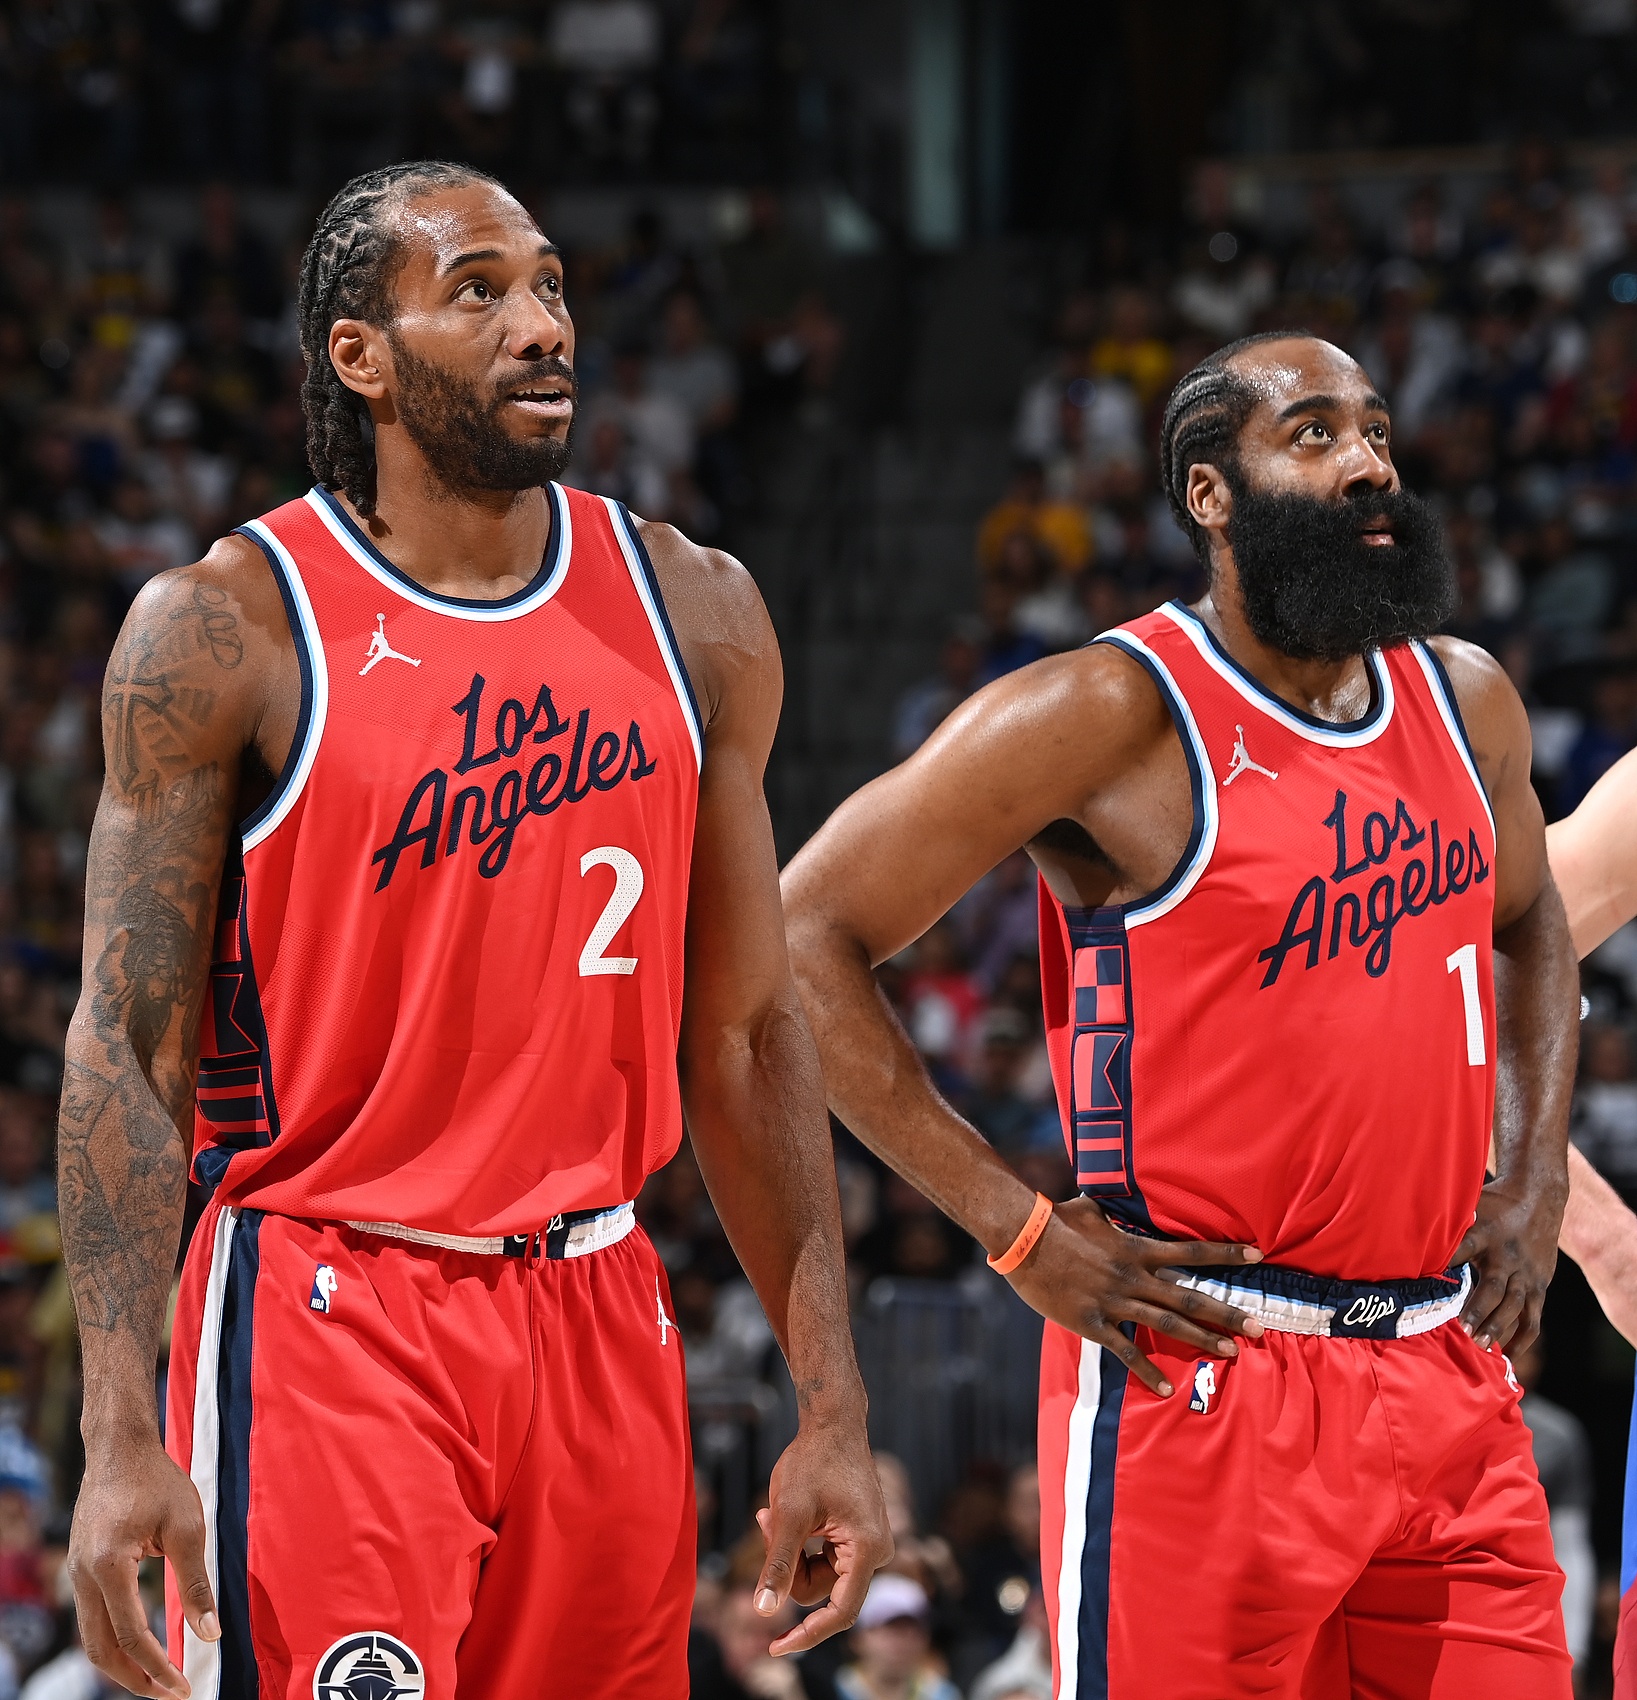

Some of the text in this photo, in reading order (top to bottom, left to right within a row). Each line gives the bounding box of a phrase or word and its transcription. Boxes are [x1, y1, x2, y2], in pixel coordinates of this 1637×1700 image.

[450, 672, 570, 776] Los
[371, 708, 657, 894] Angeles
[1322, 788, 1426, 884] Los
[578, 845, 644, 977] 2
[1257, 819, 1489, 991] Angeles
[1445, 943, 1487, 1067] 1
[310, 1297, 325, 1310] NBA
[1343, 1294, 1397, 1328] Clips
